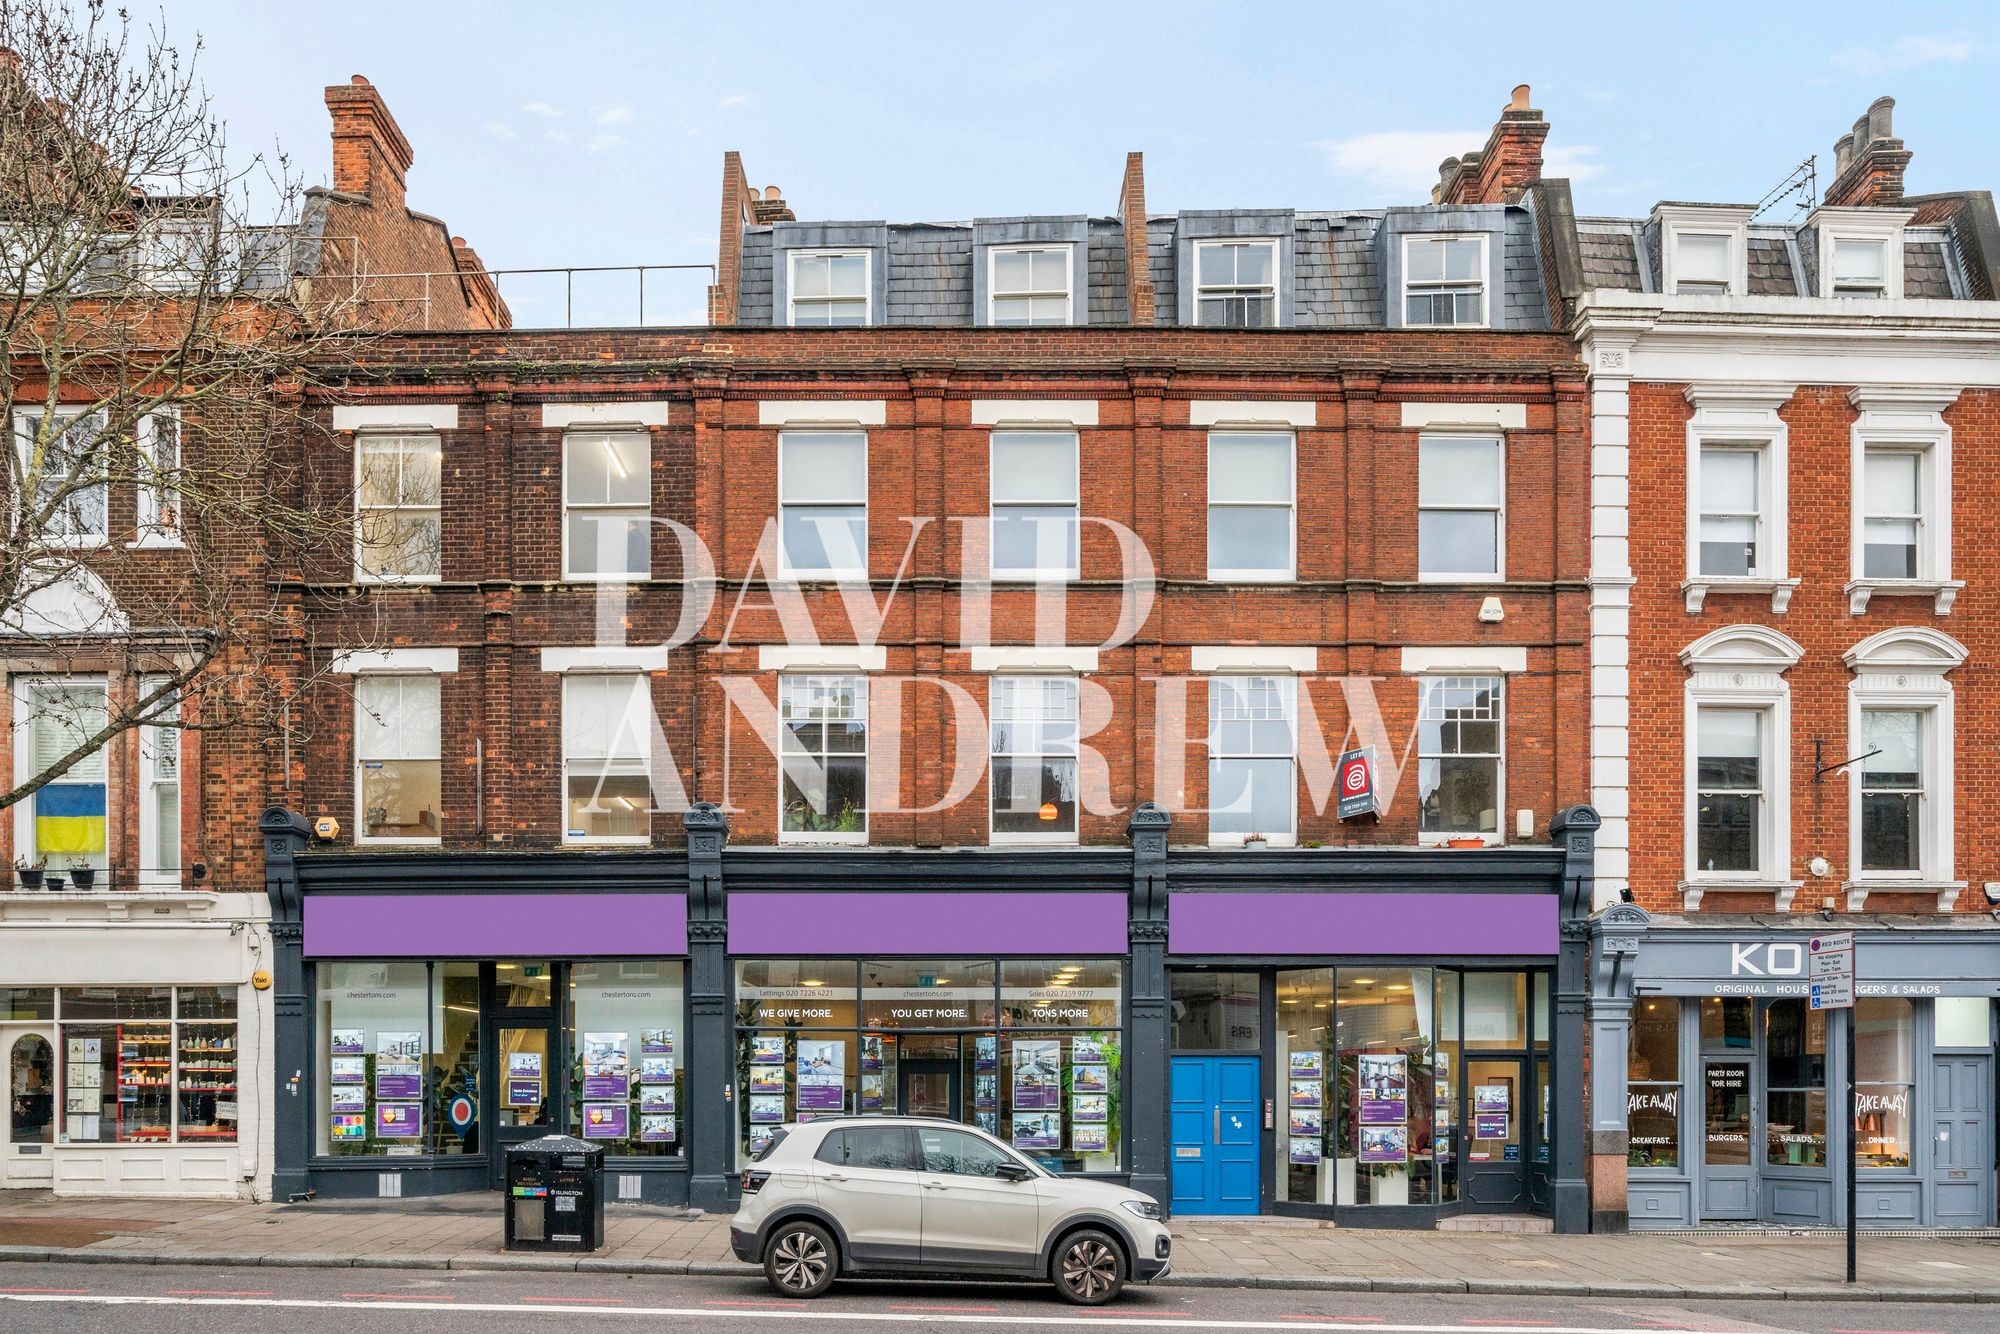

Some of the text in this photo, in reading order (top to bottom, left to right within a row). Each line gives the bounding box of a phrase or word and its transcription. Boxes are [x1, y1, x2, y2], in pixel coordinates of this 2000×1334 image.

[1832, 938, 1850, 946] ROUTE
[1731, 943, 1802, 975] KO
[255, 976, 268, 984] Yale
[760, 989, 833, 998] Lettings 020 7226 4221
[1714, 984, 1941, 994] ORIGINAL HOUS RGERS & SALADS
[346, 991, 397, 999] chestertons.com
[902, 990, 954, 998] chestertons.com
[759, 1009, 833, 1018] WE GIVE MORE.
[891, 1009, 968, 1018] YOU GET MORE.
[1032, 1009, 1057, 1018] TONS
[1059, 1009, 1088, 1018] MORE
